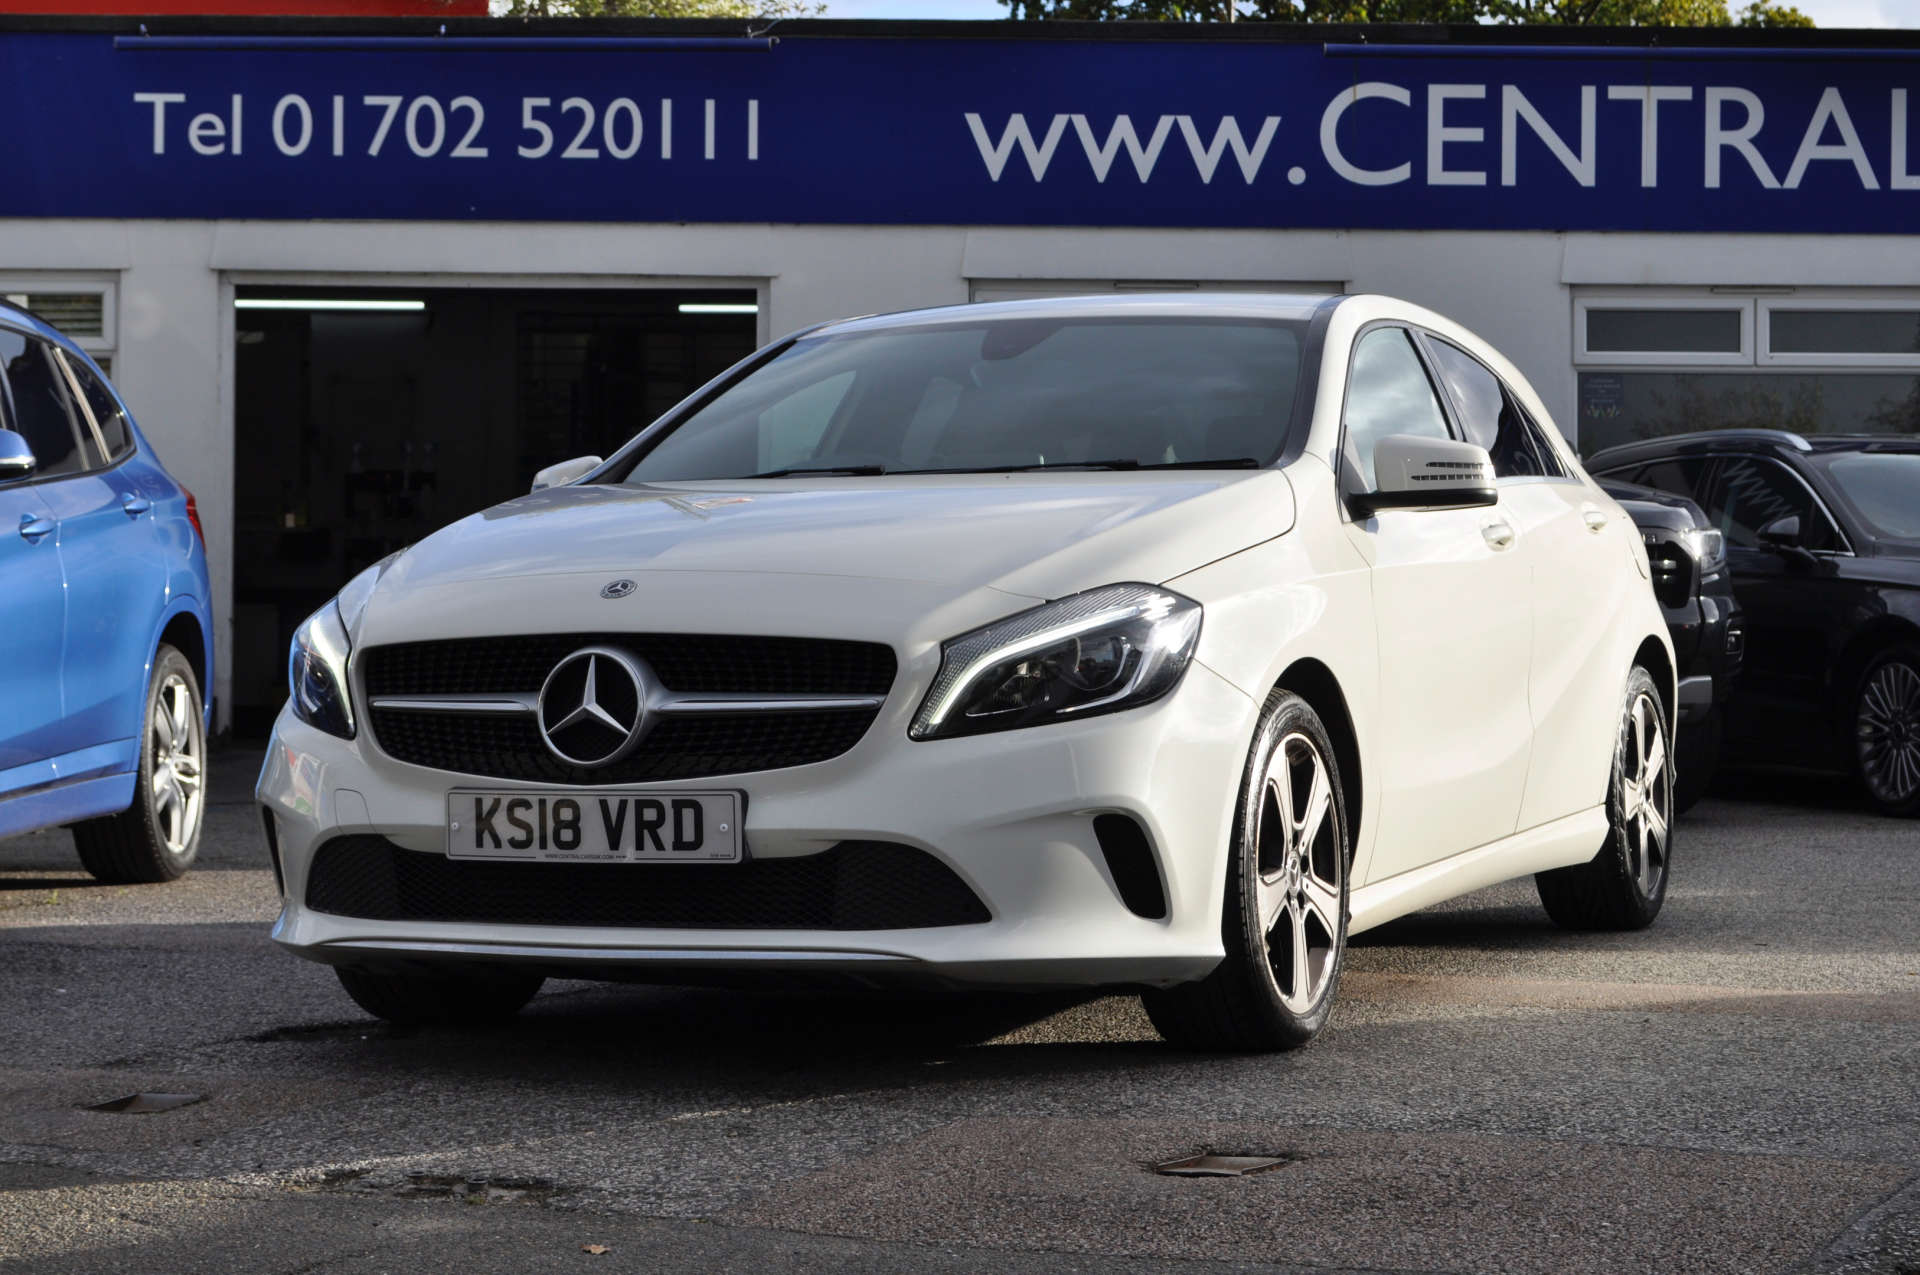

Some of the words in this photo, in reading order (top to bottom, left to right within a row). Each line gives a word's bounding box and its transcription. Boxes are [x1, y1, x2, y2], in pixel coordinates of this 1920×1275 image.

[133, 92, 243, 156] Tel
[272, 93, 489, 158] 01702
[517, 97, 760, 160] 520111
[474, 797, 582, 851] KS18
[598, 798, 705, 852] VRD
